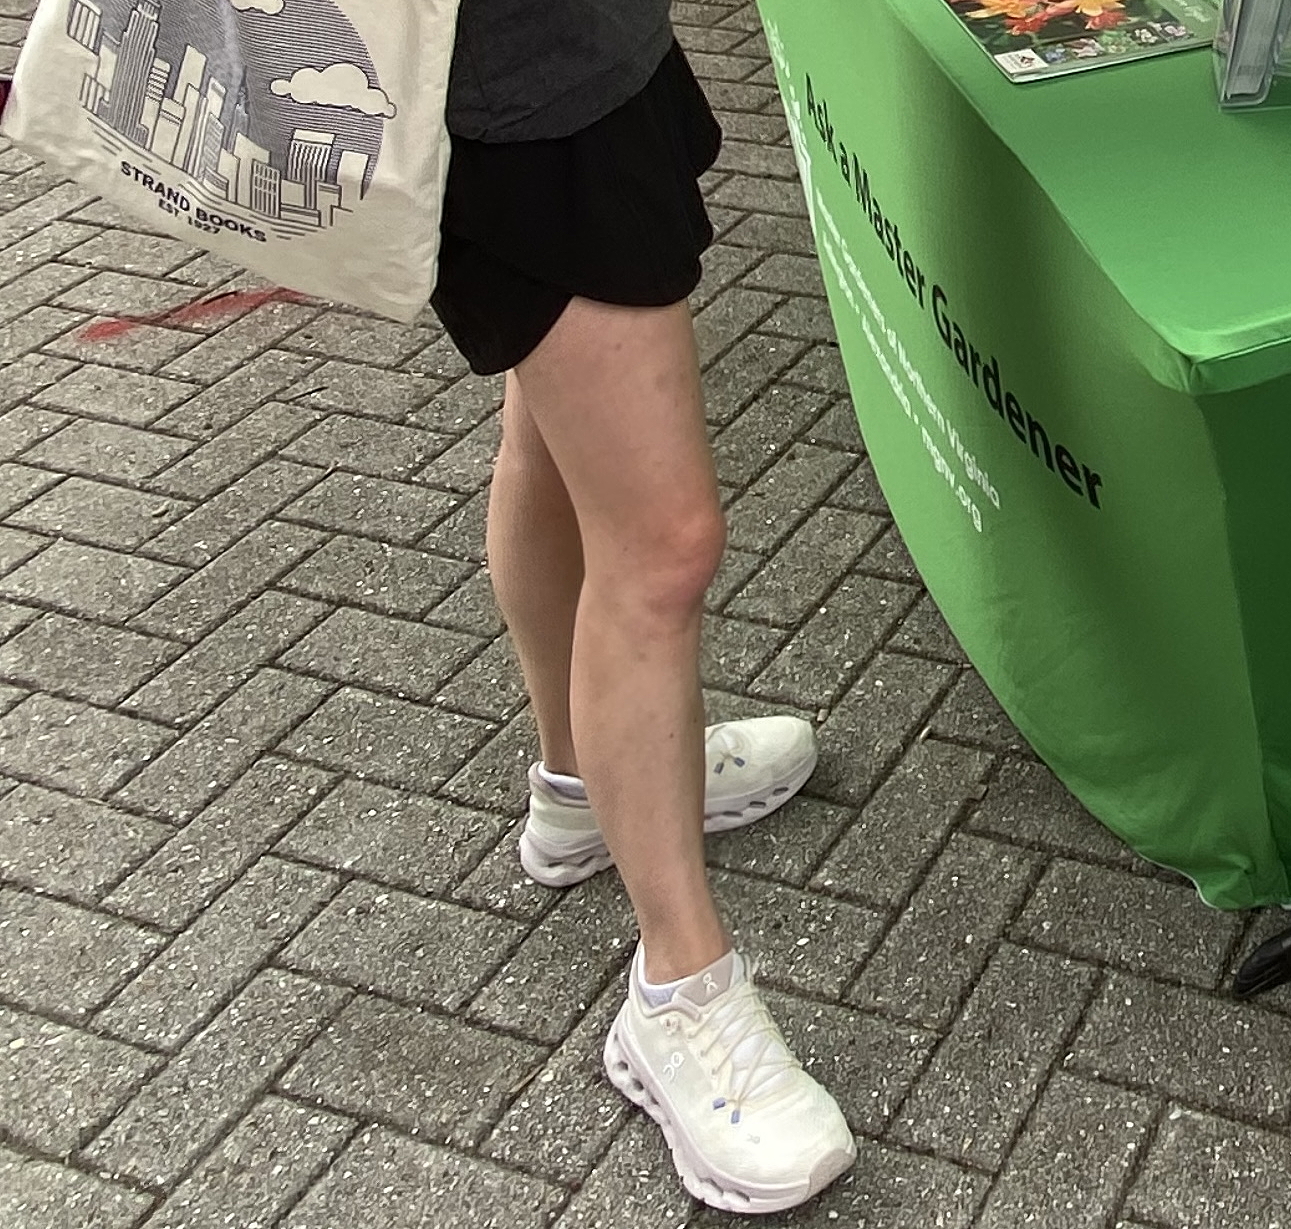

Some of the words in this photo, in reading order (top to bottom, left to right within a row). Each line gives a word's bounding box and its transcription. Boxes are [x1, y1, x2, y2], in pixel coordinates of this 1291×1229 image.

[119, 159, 192, 213] STRAND
[195, 206, 268, 243] BOOKS
[805, 71, 839, 165] Ask
[838, 140, 852, 189] a
[851, 151, 925, 311] Master
[931, 283, 1103, 511] Gardener
